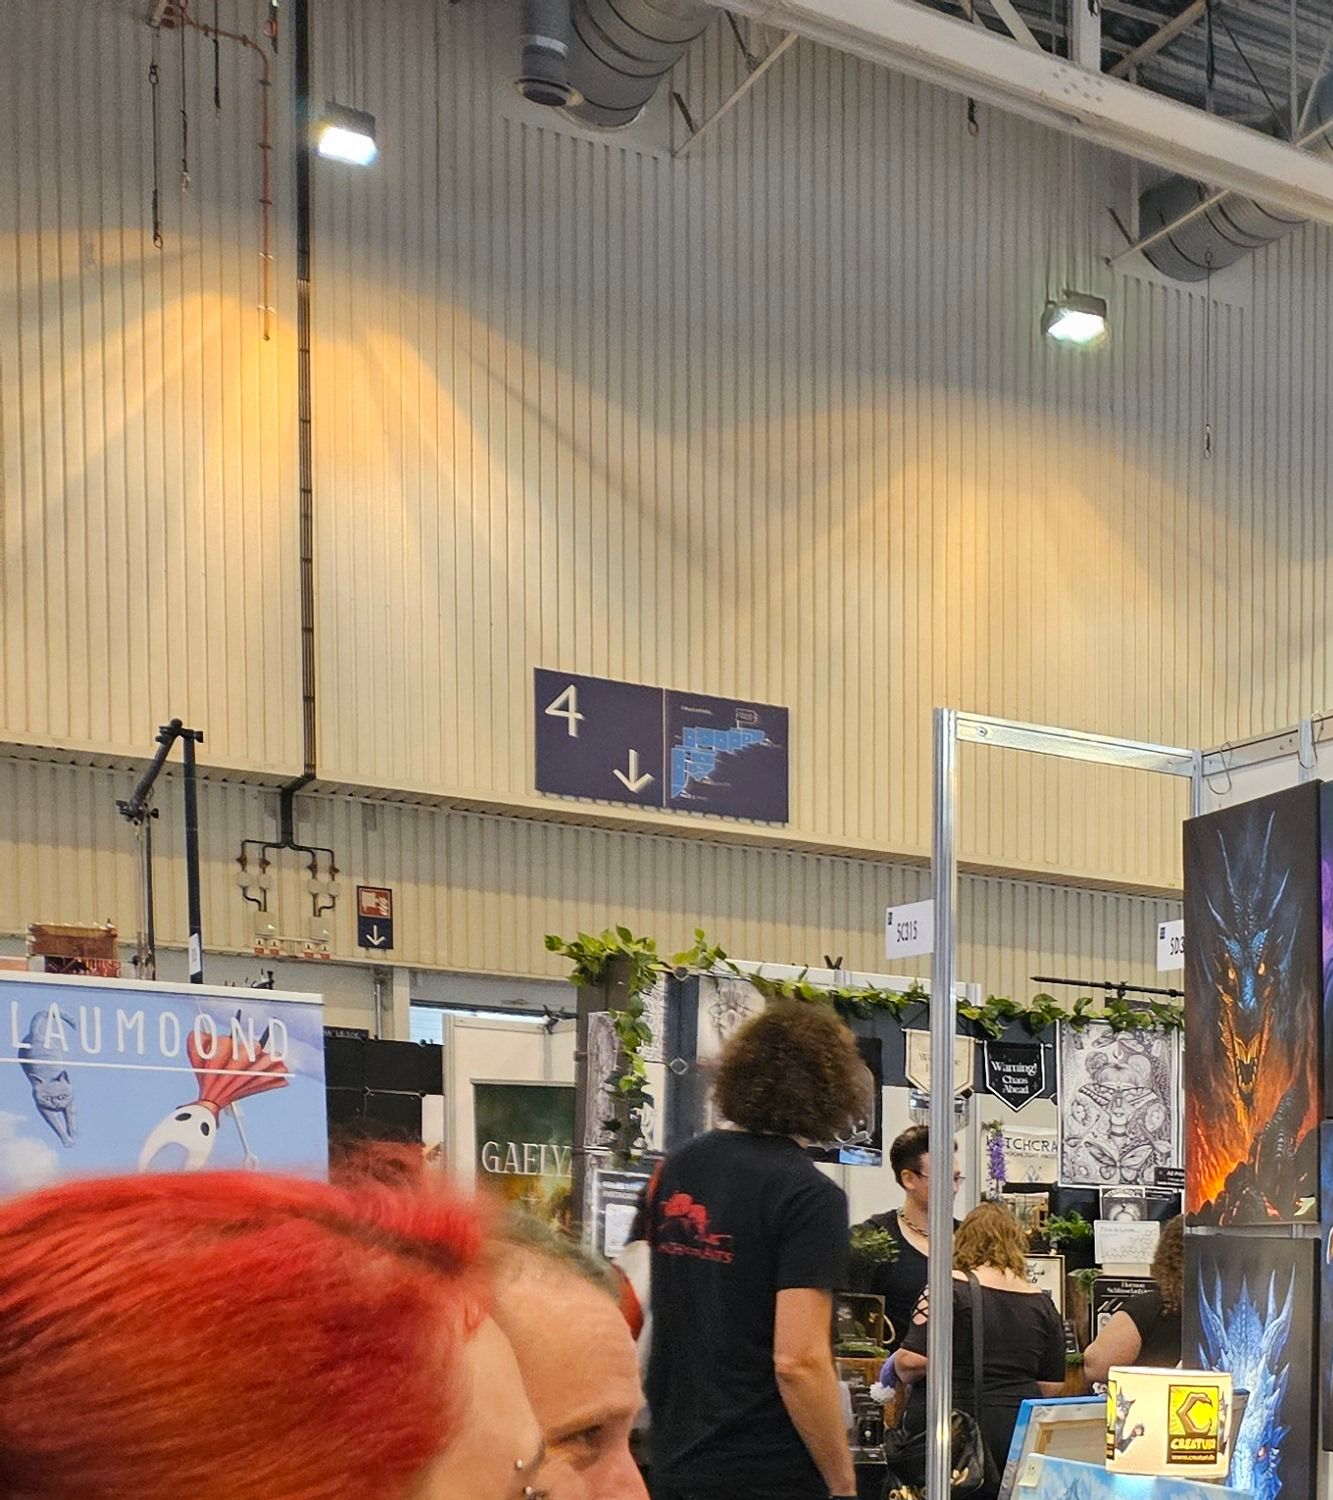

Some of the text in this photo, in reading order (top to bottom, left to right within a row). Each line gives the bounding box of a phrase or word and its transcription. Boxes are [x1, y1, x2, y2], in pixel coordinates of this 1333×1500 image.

[545, 684, 585, 738] 4
[9, 1002, 289, 1063] LAUMOOND
[992, 1061, 1038, 1075] Warning!
[1002, 1075, 1028, 1085] Chaos
